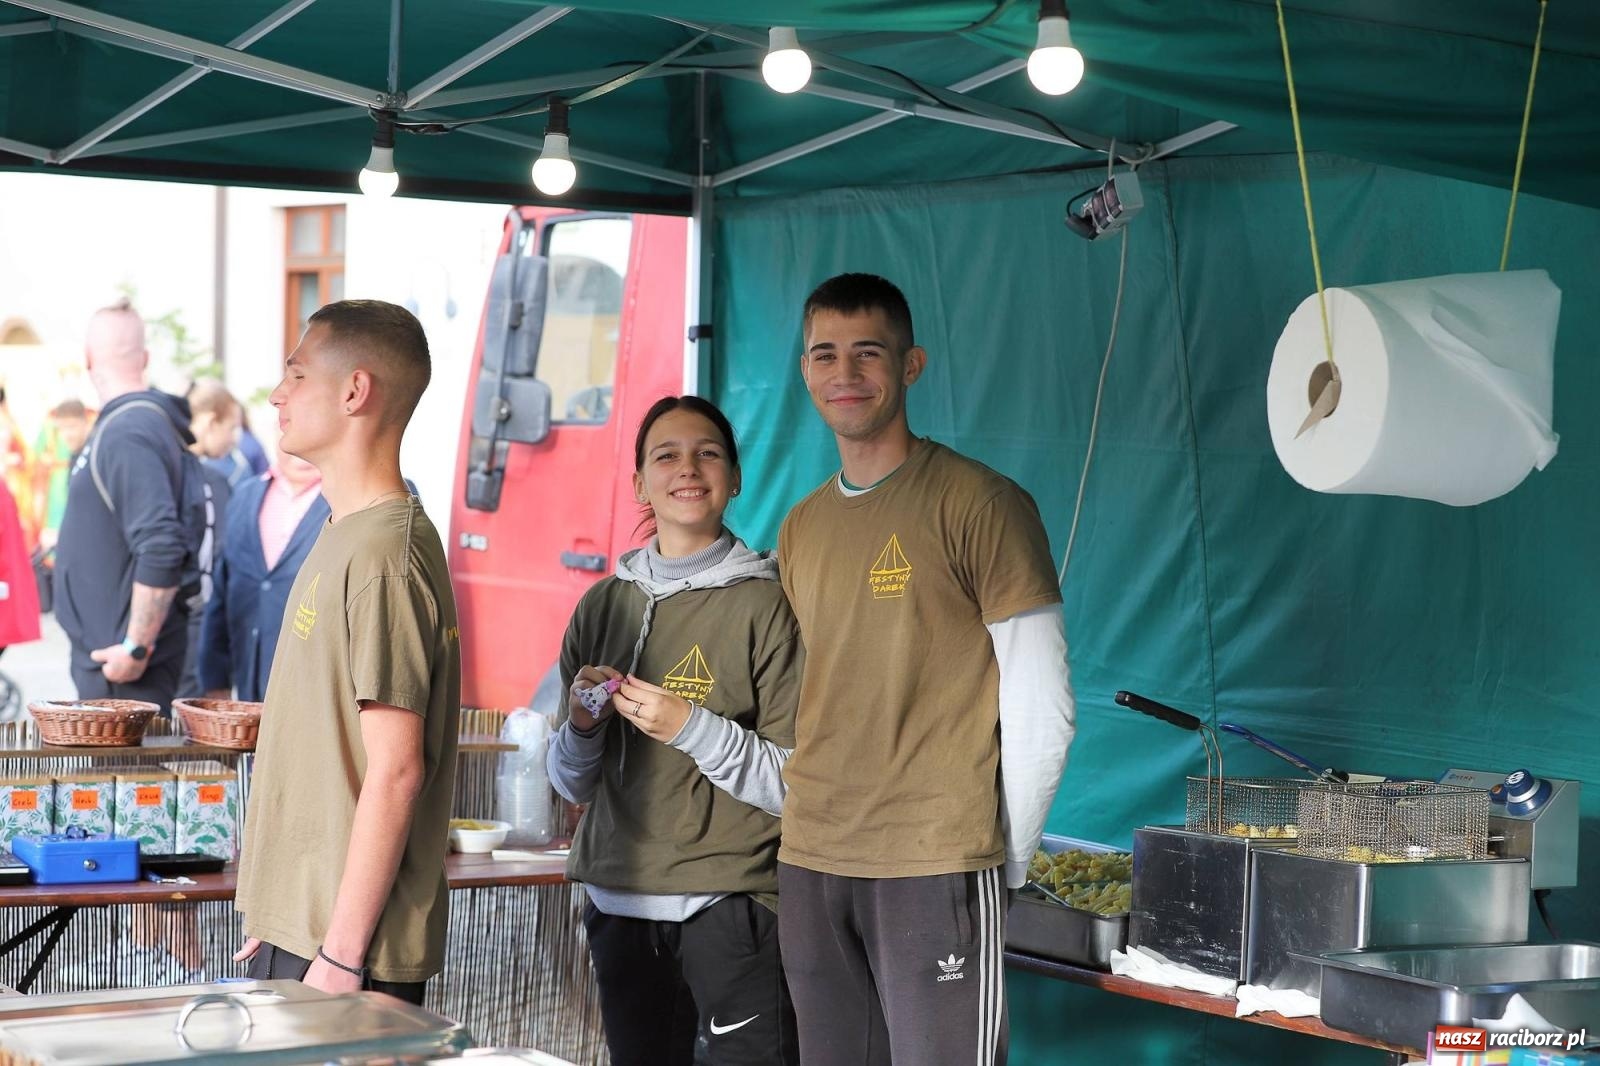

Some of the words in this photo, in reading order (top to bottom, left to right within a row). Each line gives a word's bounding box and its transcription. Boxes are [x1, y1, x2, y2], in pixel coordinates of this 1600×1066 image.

[868, 573, 911, 585] FESTYNY
[872, 583, 906, 593] DAREK
[662, 681, 714, 694] FESTYNY
[669, 690, 707, 701] AREK
[937, 972, 964, 982] adidas
